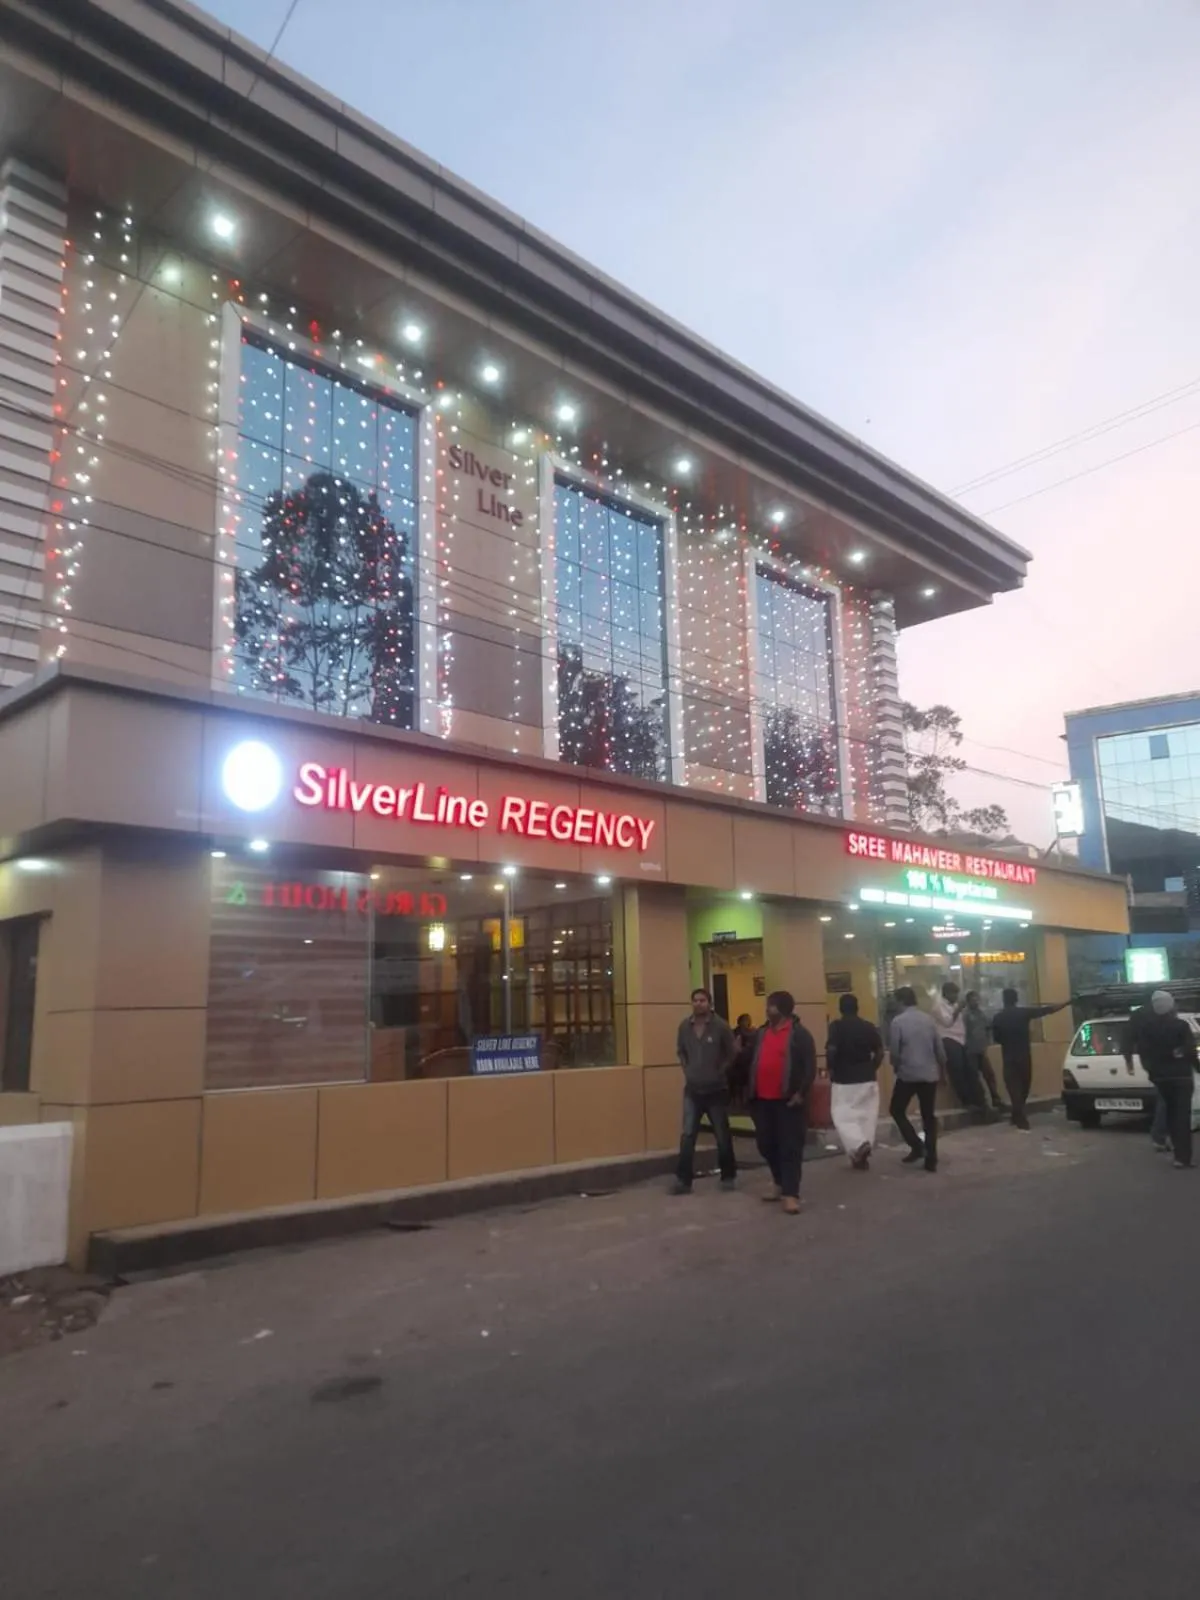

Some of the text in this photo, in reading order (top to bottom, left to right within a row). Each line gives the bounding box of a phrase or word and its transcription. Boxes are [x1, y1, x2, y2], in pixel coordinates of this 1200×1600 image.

[448, 443, 512, 490] Silver
[477, 488, 524, 527] Line
[293, 762, 656, 850] SilverLine REGENCY
[848, 833, 1036, 885] SREE MAHAVEER RESTAURANT
